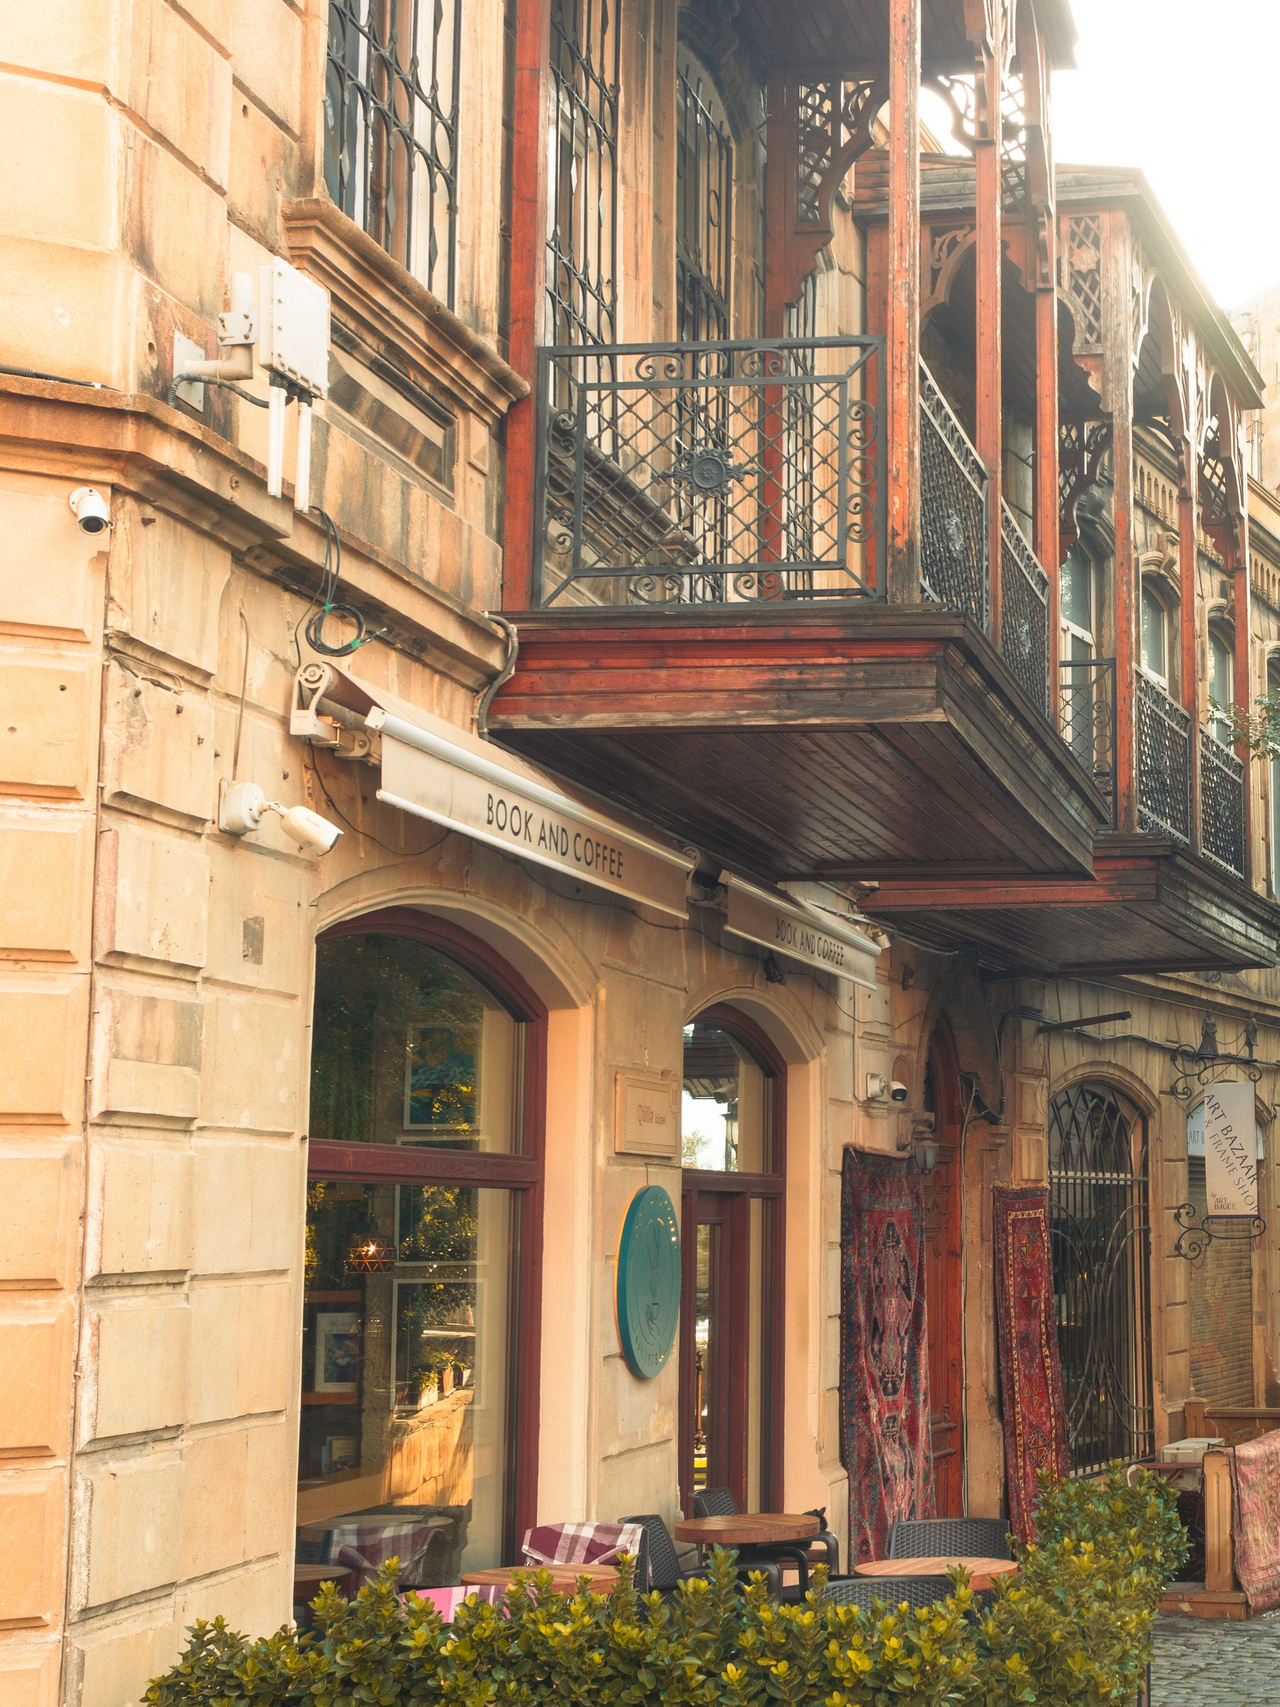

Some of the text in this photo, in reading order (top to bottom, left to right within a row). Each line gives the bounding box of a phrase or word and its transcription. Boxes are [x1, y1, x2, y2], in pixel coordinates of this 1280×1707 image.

[487, 793, 624, 879] BOOK AND COFFEE
[775, 916, 845, 966] BOOK AND COFFEE
[1204, 1119, 1259, 1212] & FRAME SHOP
[1205, 1094, 1258, 1186] ART BAZAAR
[1214, 1203, 1236, 1211] BAGET
